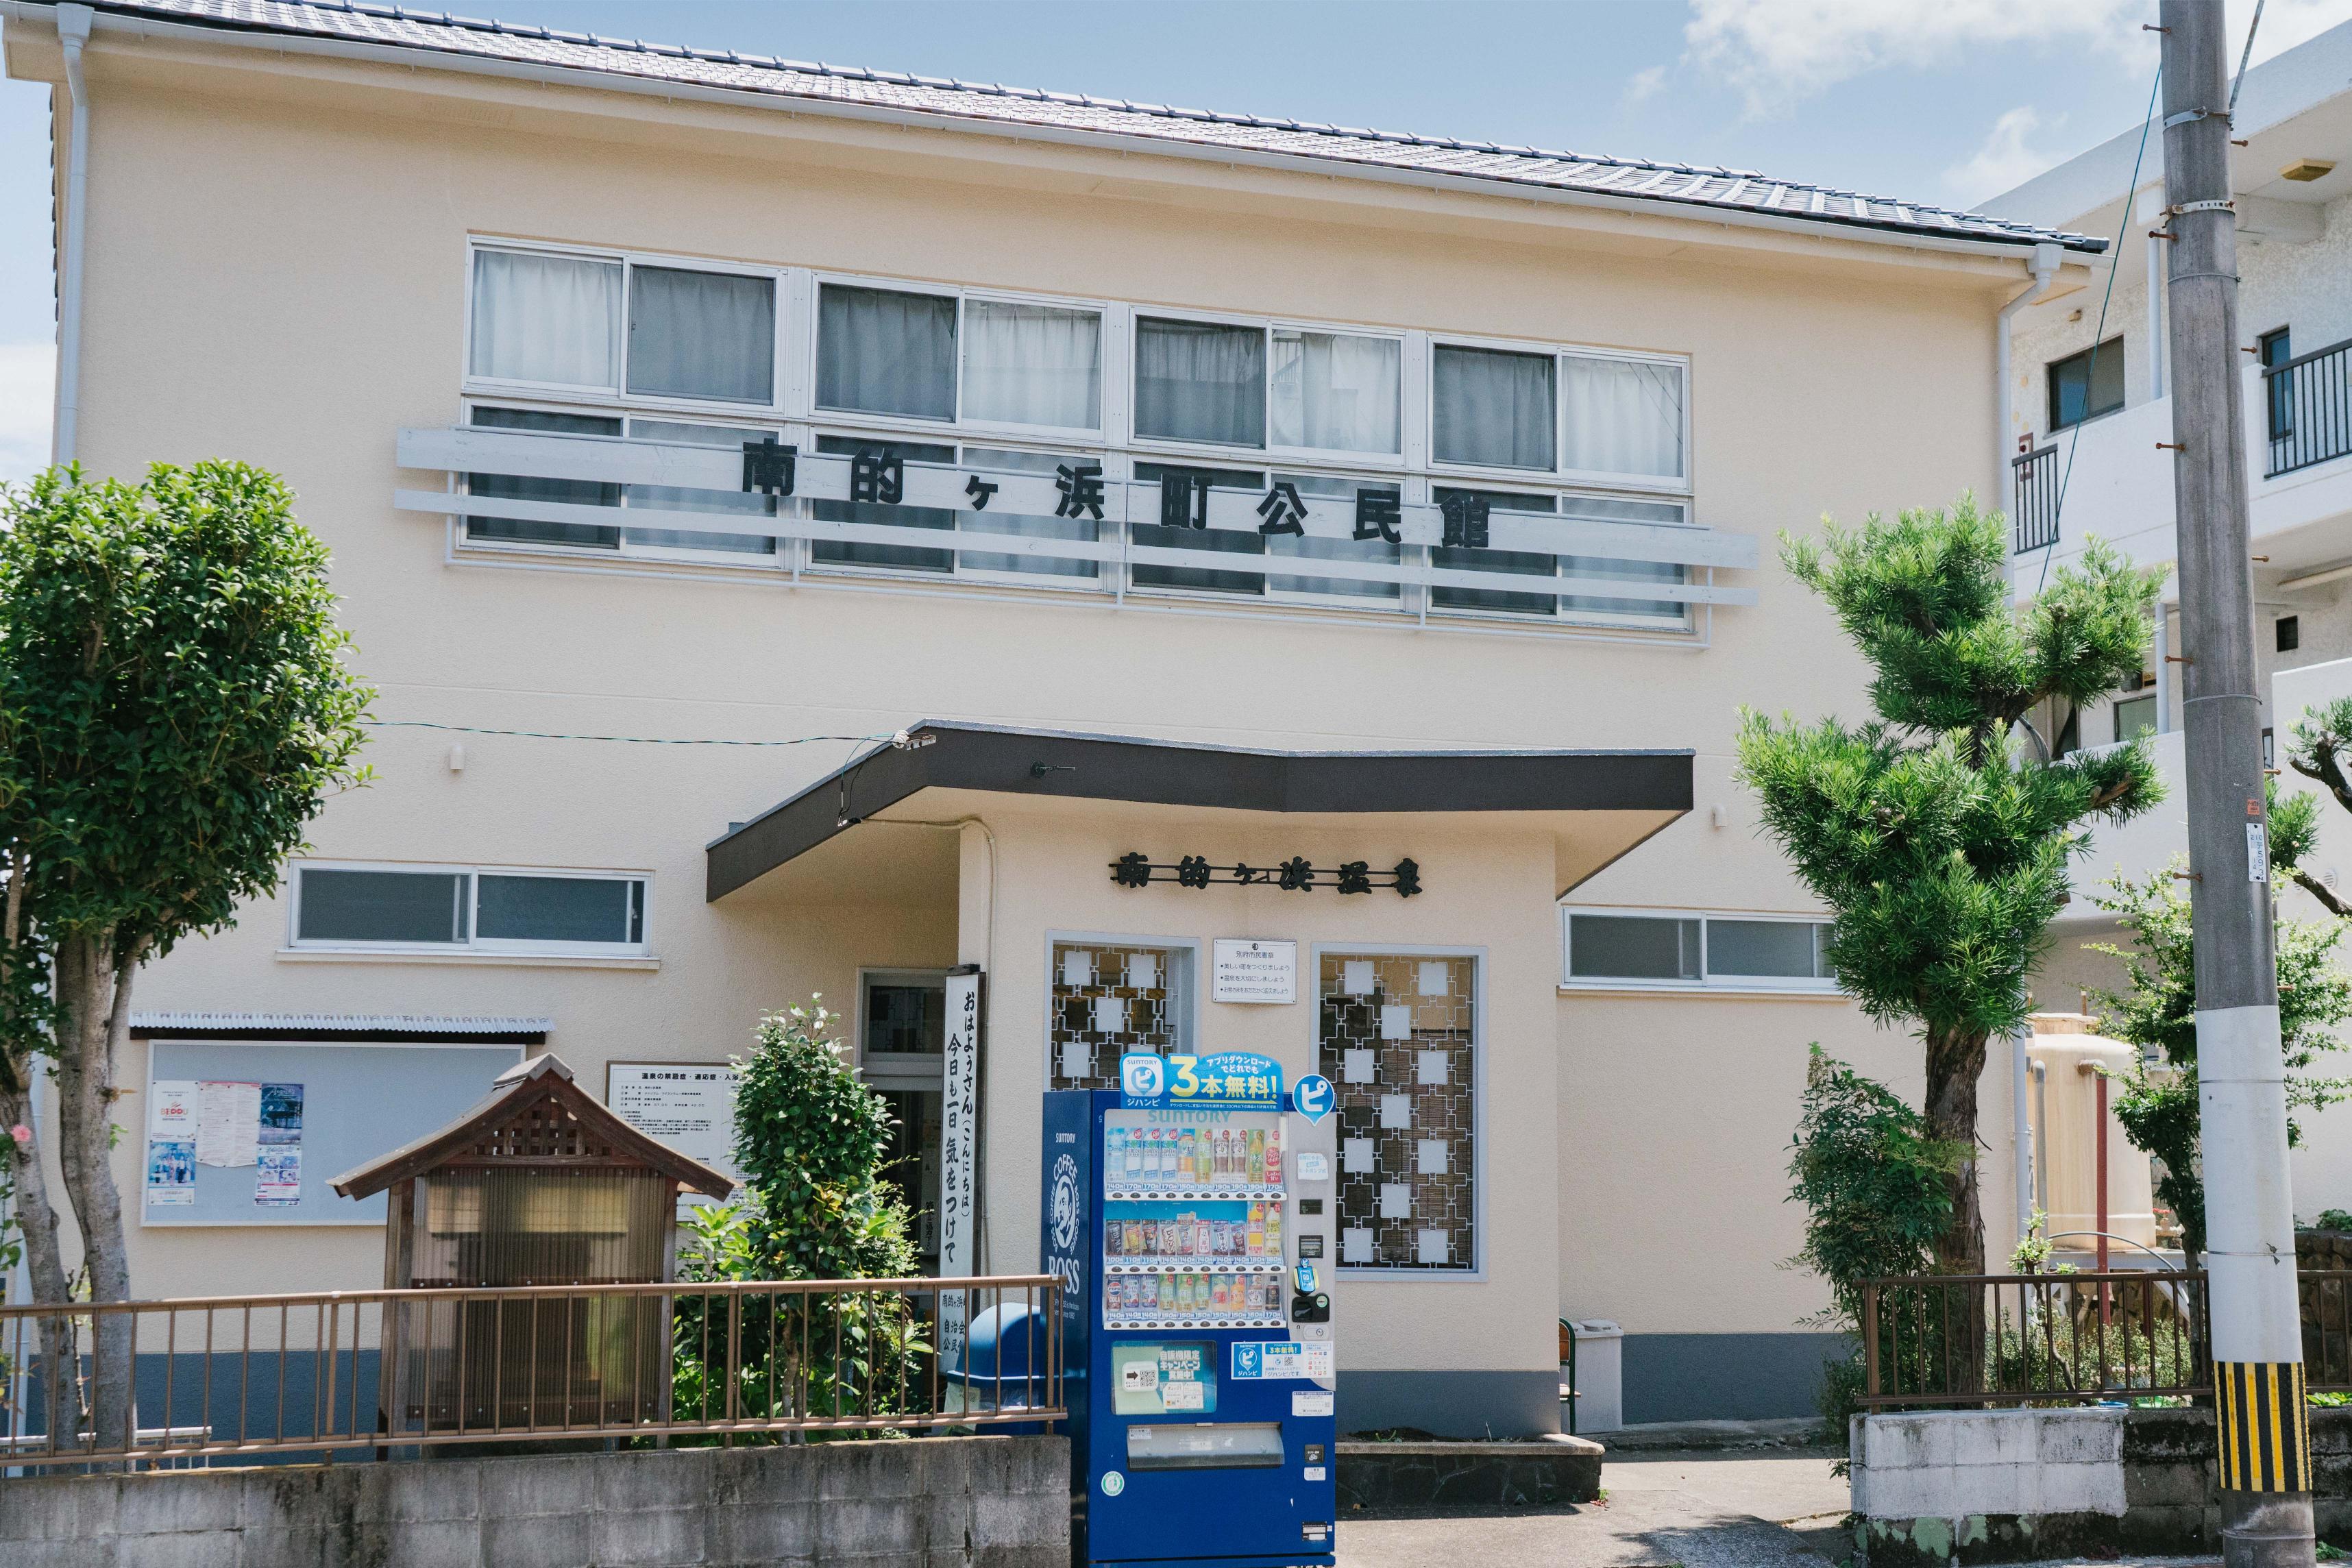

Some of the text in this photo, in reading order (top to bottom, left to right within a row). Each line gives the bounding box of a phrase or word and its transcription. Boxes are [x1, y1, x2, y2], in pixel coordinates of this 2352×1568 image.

[1236, 951, 1274, 959] 別府市民憲章
[1223, 963, 1290, 971] 美しい町をつくりましょう
[1223, 975, 1285, 983] 温泉を大切にしましょう
[1206, 1055, 1272, 1069] アプリダウンロード
[1221, 1064, 1260, 1075] でどれでも
[641, 1073, 747, 1081] 温泉の禁忌症・適応症・入浴
[1127, 1097, 1161, 1107] ジハンピ
[1148, 1110, 1233, 1123] SUNTORY
[1055, 1132, 1075, 1144] SUNTORY
[1053, 1153, 1078, 1184] COFFEE
[1049, 1255, 1079, 1295] BOSS
[942, 1294, 965, 1309] 南的ヶ浜
[1160, 1360, 1201, 1371] キャンペーン
